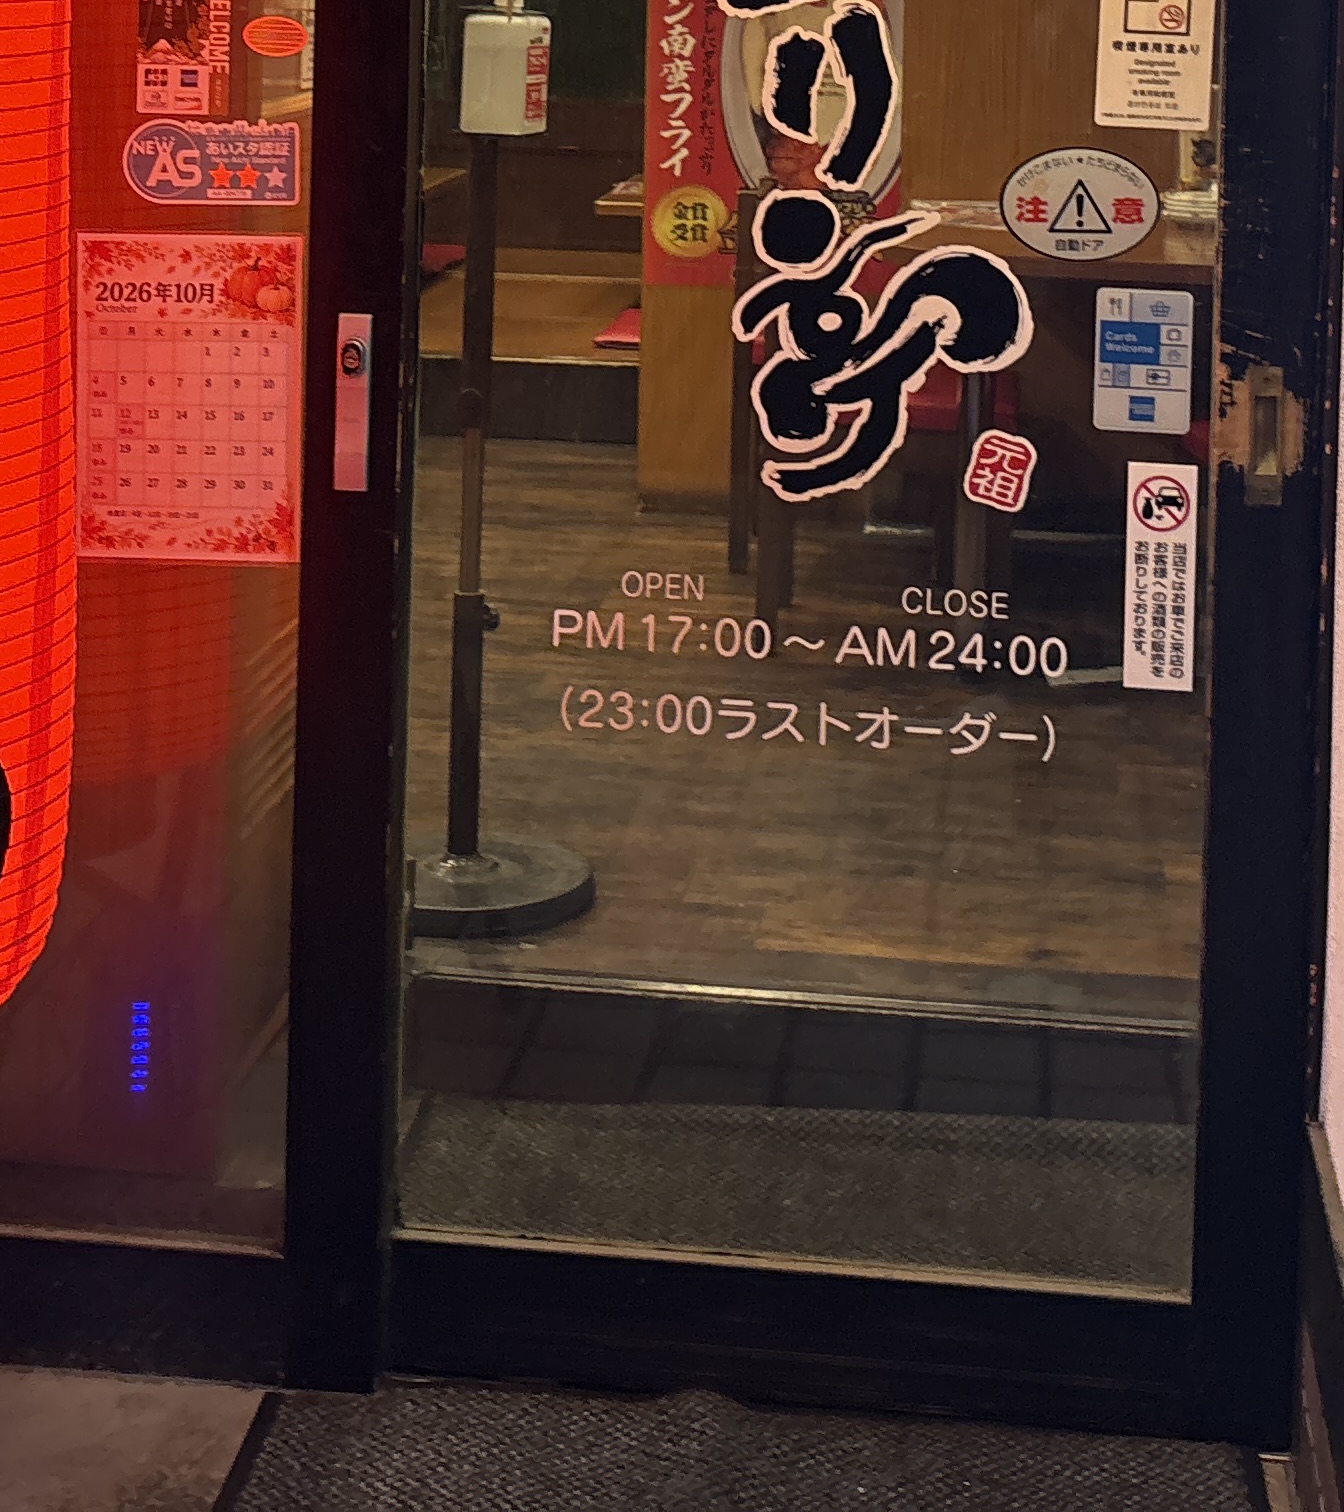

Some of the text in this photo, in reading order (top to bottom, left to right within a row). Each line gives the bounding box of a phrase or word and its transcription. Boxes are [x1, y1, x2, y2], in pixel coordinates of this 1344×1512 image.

[132, 138, 175, 155] NEW
[1055, 238, 1104, 251] 自動ドア
[95, 282, 215, 304] 2026年10月
[970, 438, 1027, 505] 元祖
[621, 570, 706, 602] OPEN
[902, 586, 1010, 620] CLOSE
[553, 609, 625, 651] PM
[835, 626, 917, 669] AM
[928, 632, 1069, 679] 24:00
